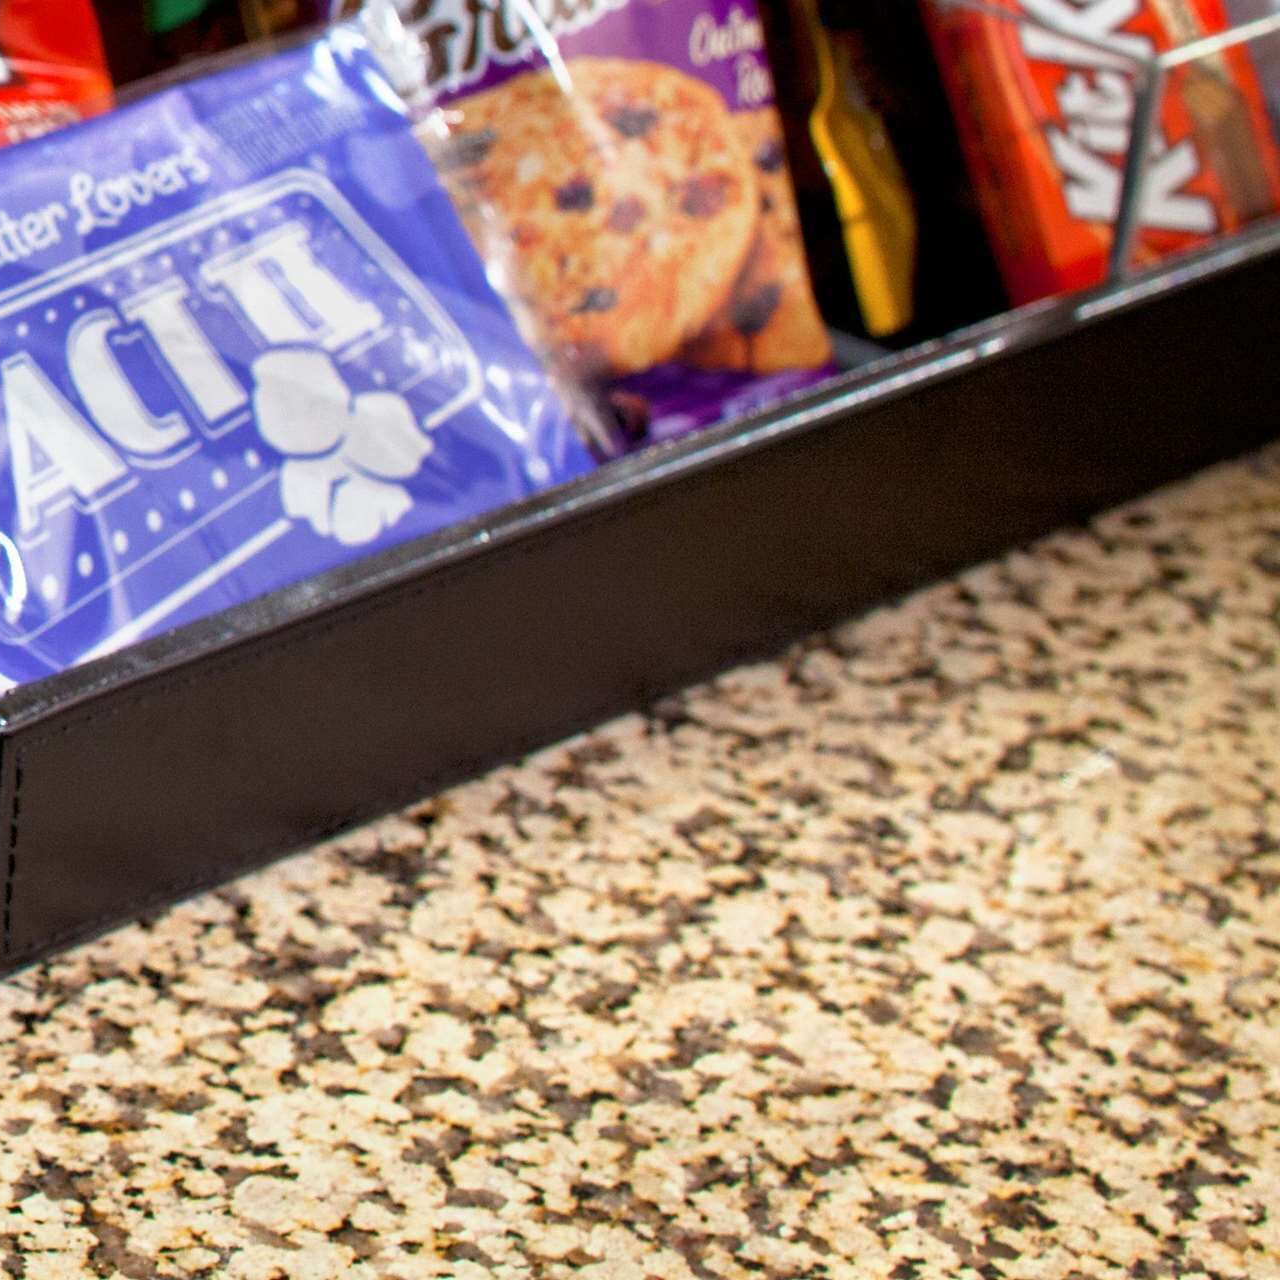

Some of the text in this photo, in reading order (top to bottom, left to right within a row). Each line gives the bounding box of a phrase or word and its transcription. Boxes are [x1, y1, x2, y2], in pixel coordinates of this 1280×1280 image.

[70, 139, 210, 235] Lovers
[0, 223, 388, 542] ACT II
